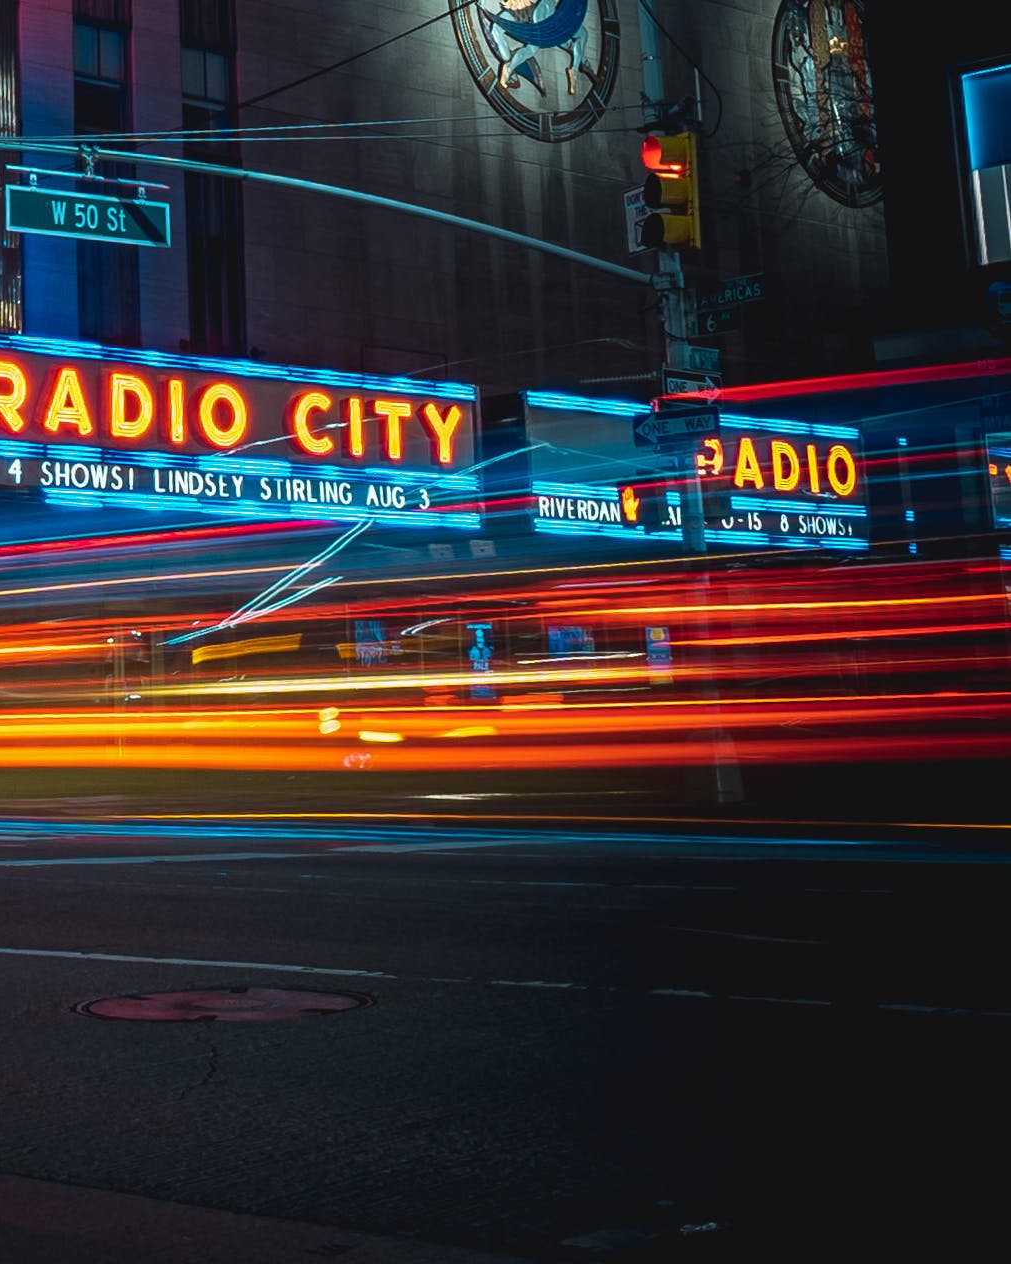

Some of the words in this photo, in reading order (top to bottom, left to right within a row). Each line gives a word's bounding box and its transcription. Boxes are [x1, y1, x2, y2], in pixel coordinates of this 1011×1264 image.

[51, 200, 67, 226] W
[74, 203, 99, 230] 50
[107, 207, 126, 233] St
[707, 312, 717, 333] 6
[294, 391, 463, 464] CITY
[642, 421, 669, 435] ONE
[684, 415, 711, 432] WAY
[7, 458, 23, 485] 4
[154, 469, 245, 499] LINDSEY
[260, 477, 354, 506] STIRLING
[366, 484, 407, 511] AUG
[419, 488, 432, 511] 3
[538, 494, 621, 523] RIVERDAN
[780, 513, 790, 533] 8
